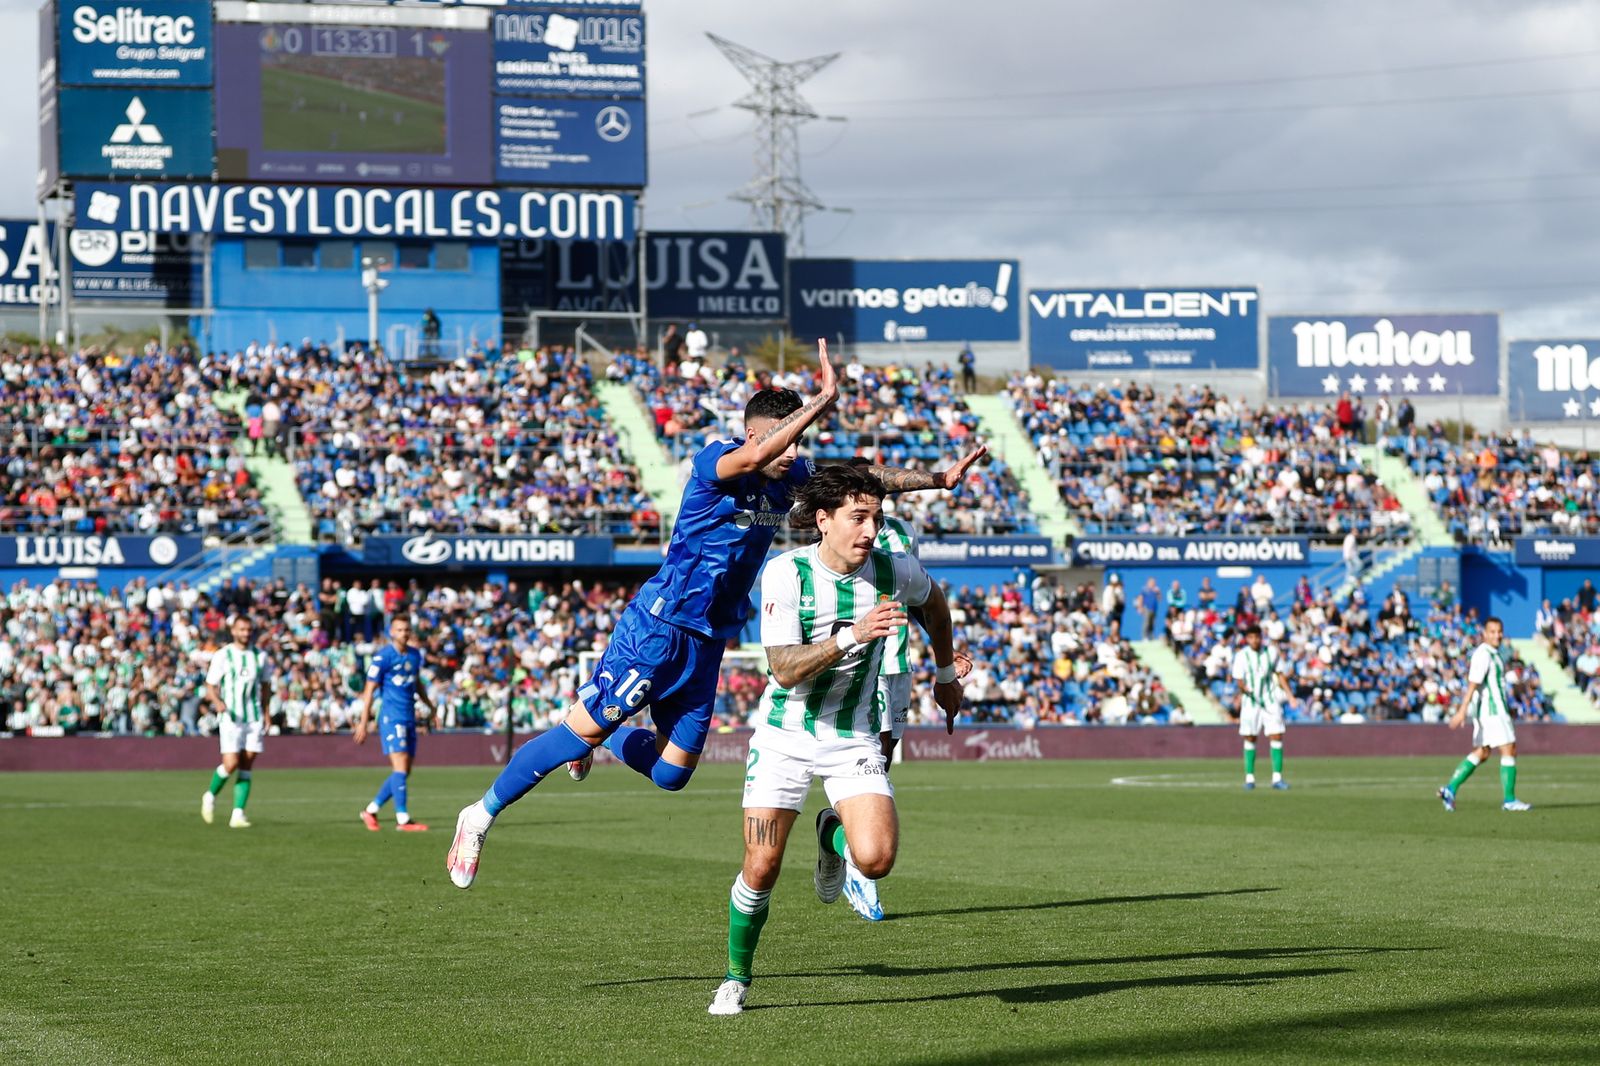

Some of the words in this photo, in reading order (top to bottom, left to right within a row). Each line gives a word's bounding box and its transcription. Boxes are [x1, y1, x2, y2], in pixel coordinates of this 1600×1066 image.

[72, 6, 195, 44] Selitrac
[284, 28, 302, 53] 0
[319, 31, 389, 53] 13:31
[410, 32, 424, 56] 1
[697, 296, 780, 313] IMELCO
[801, 286, 899, 308] vamos
[1029, 292, 1258, 318] VITALDENT
[1292, 318, 1475, 367] Mahou
[15, 536, 125, 565] LUJISA
[455, 539, 575, 562] HYUNDAI
[1076, 541, 1154, 561] CIUDAD
[1184, 537, 1304, 561] AUTOMÓVIL
[614, 668, 652, 708] 16
[910, 740, 951, 758] Visit
[748, 816, 778, 849] TWO
